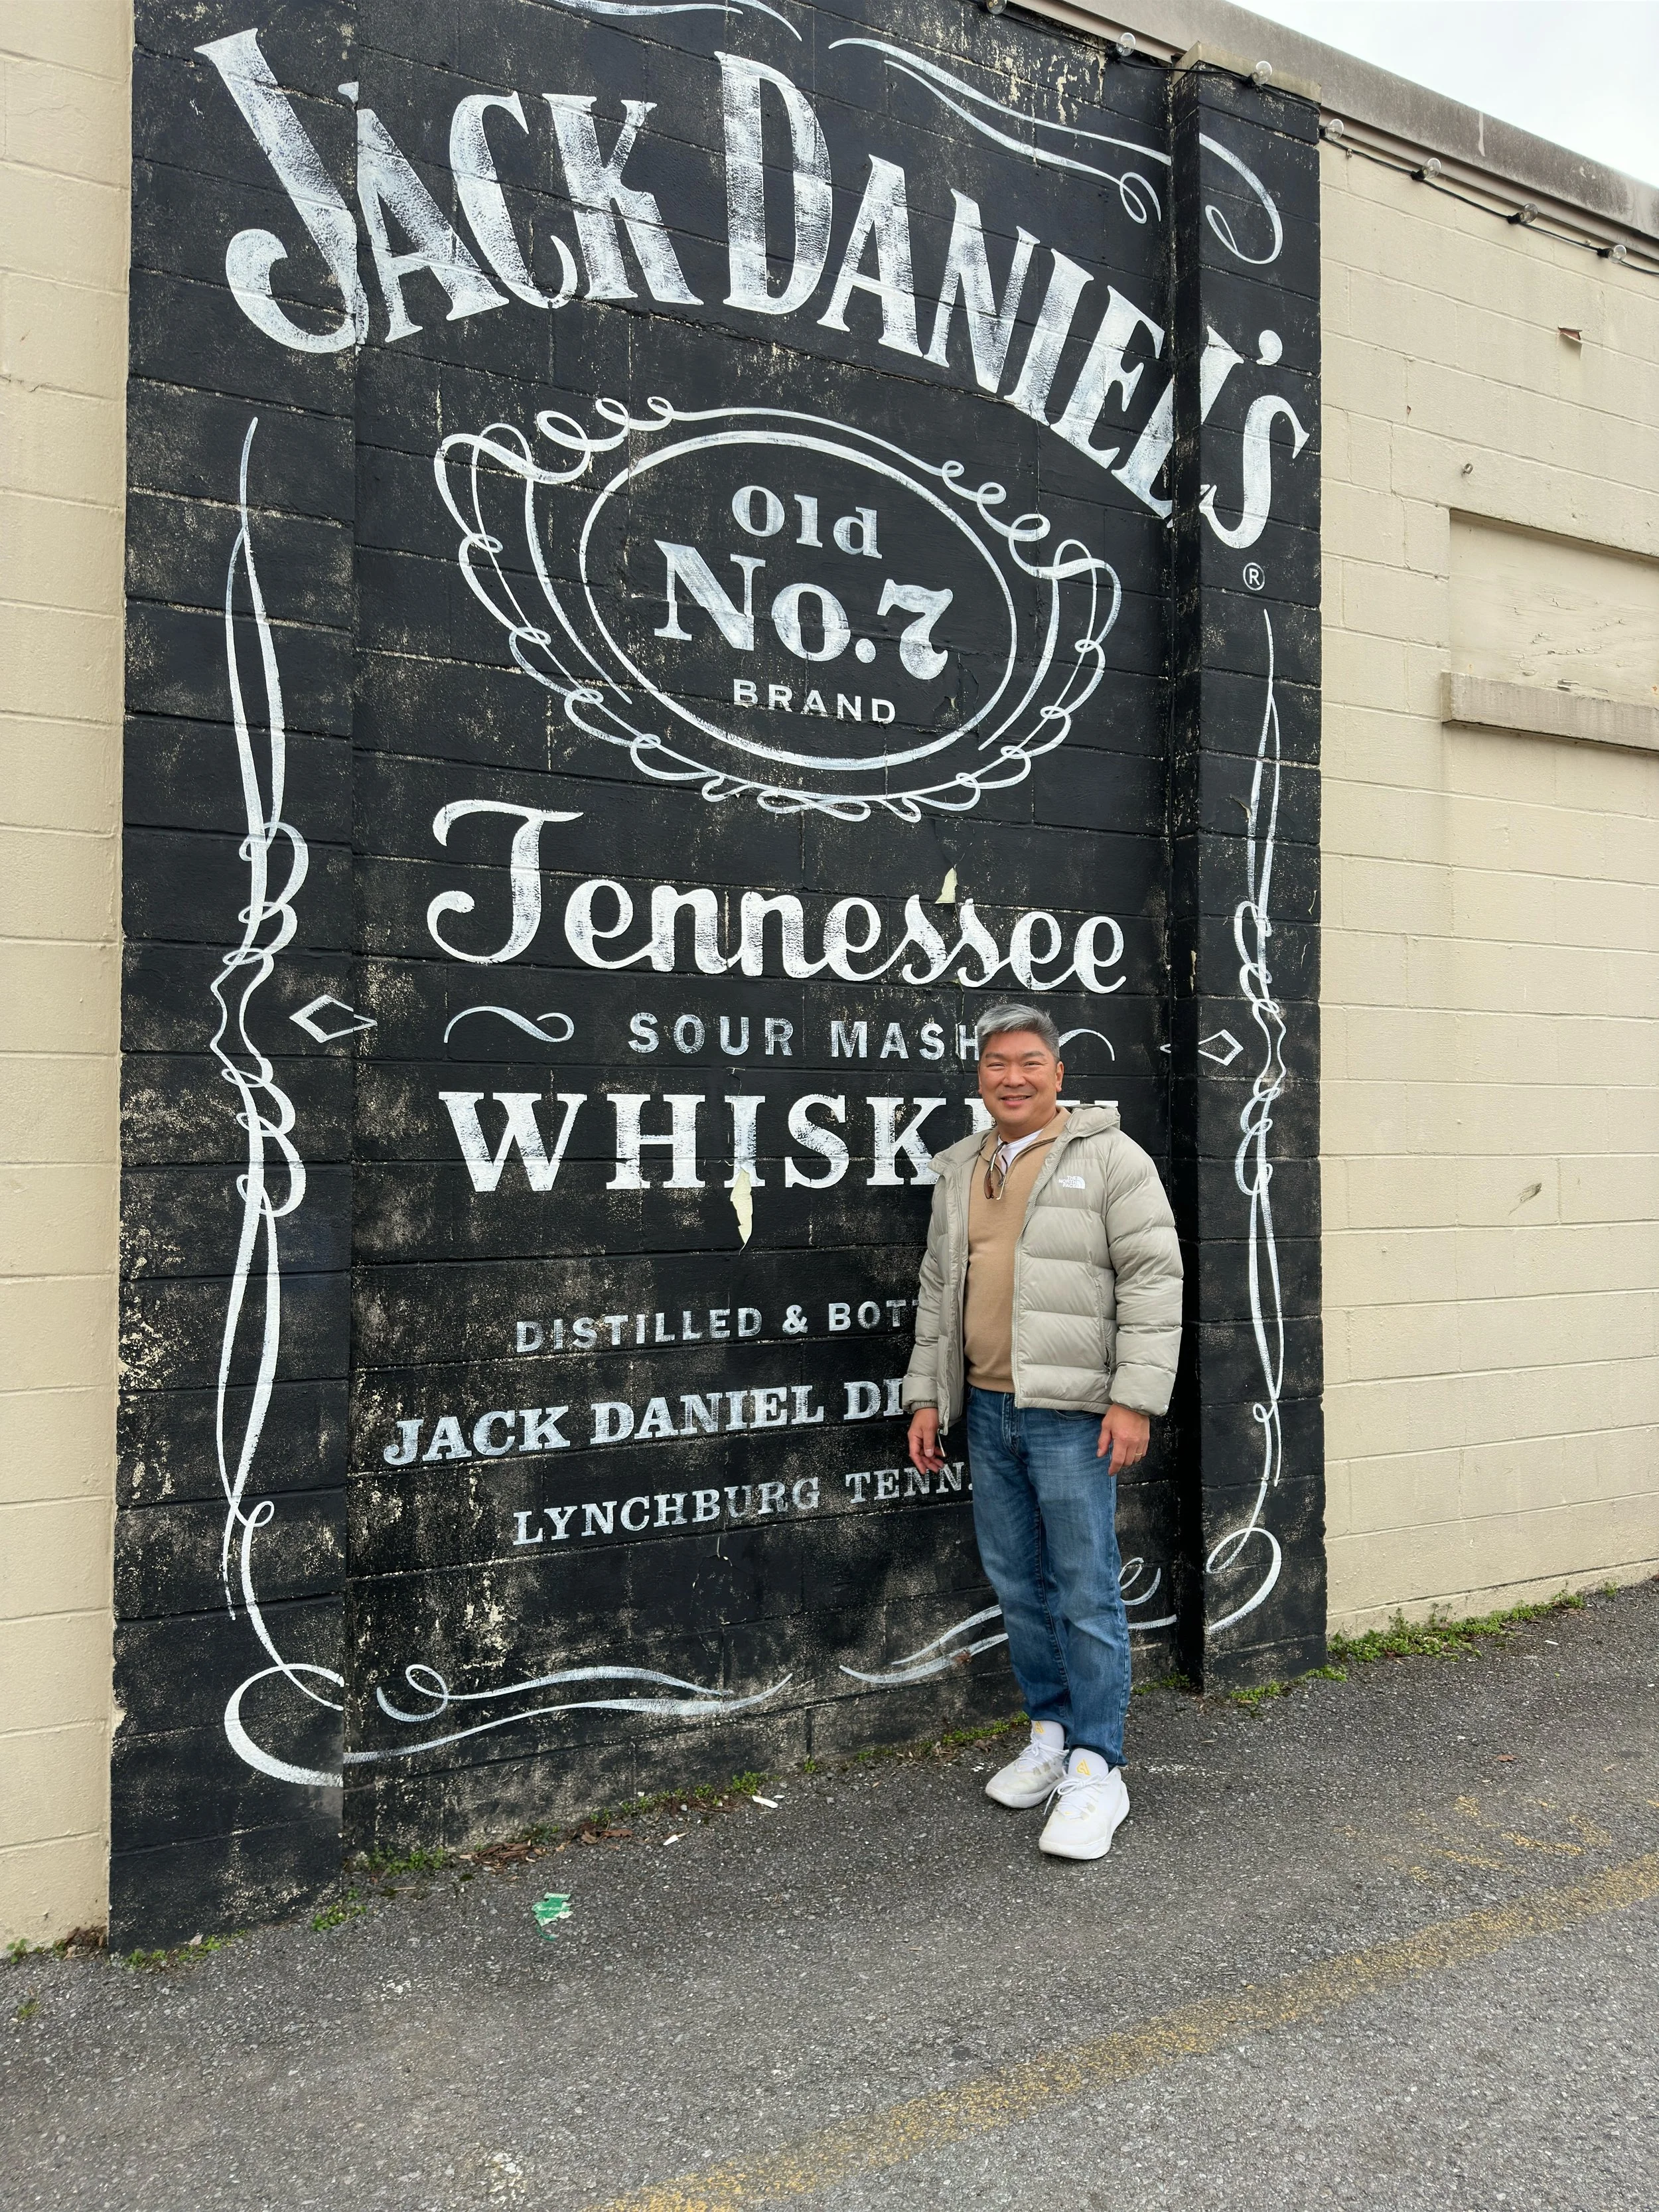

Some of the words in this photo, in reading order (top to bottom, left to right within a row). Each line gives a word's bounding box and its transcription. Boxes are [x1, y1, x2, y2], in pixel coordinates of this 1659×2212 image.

[194, 27, 703, 354] JACK
[713, 51, 1310, 549] DANIEL'S
[731, 485, 883, 559] Old
[733, 678, 896, 724] BRAND
[427, 799, 1127, 994] Tennessee
[628, 1012, 794, 1057] SOUR
[830, 1020, 979, 1061] MASH
[439, 1091, 1118, 1193] WHISK
[516, 1307, 762, 1353] DISTILLED
[782, 1304, 809, 1335] &
[828, 1299, 920, 1331] BOT
[383, 1405, 571, 1467] JACK
[591, 1384, 825, 1446] DANIEL
[513, 1477, 820, 1546] LYNCHBURG
